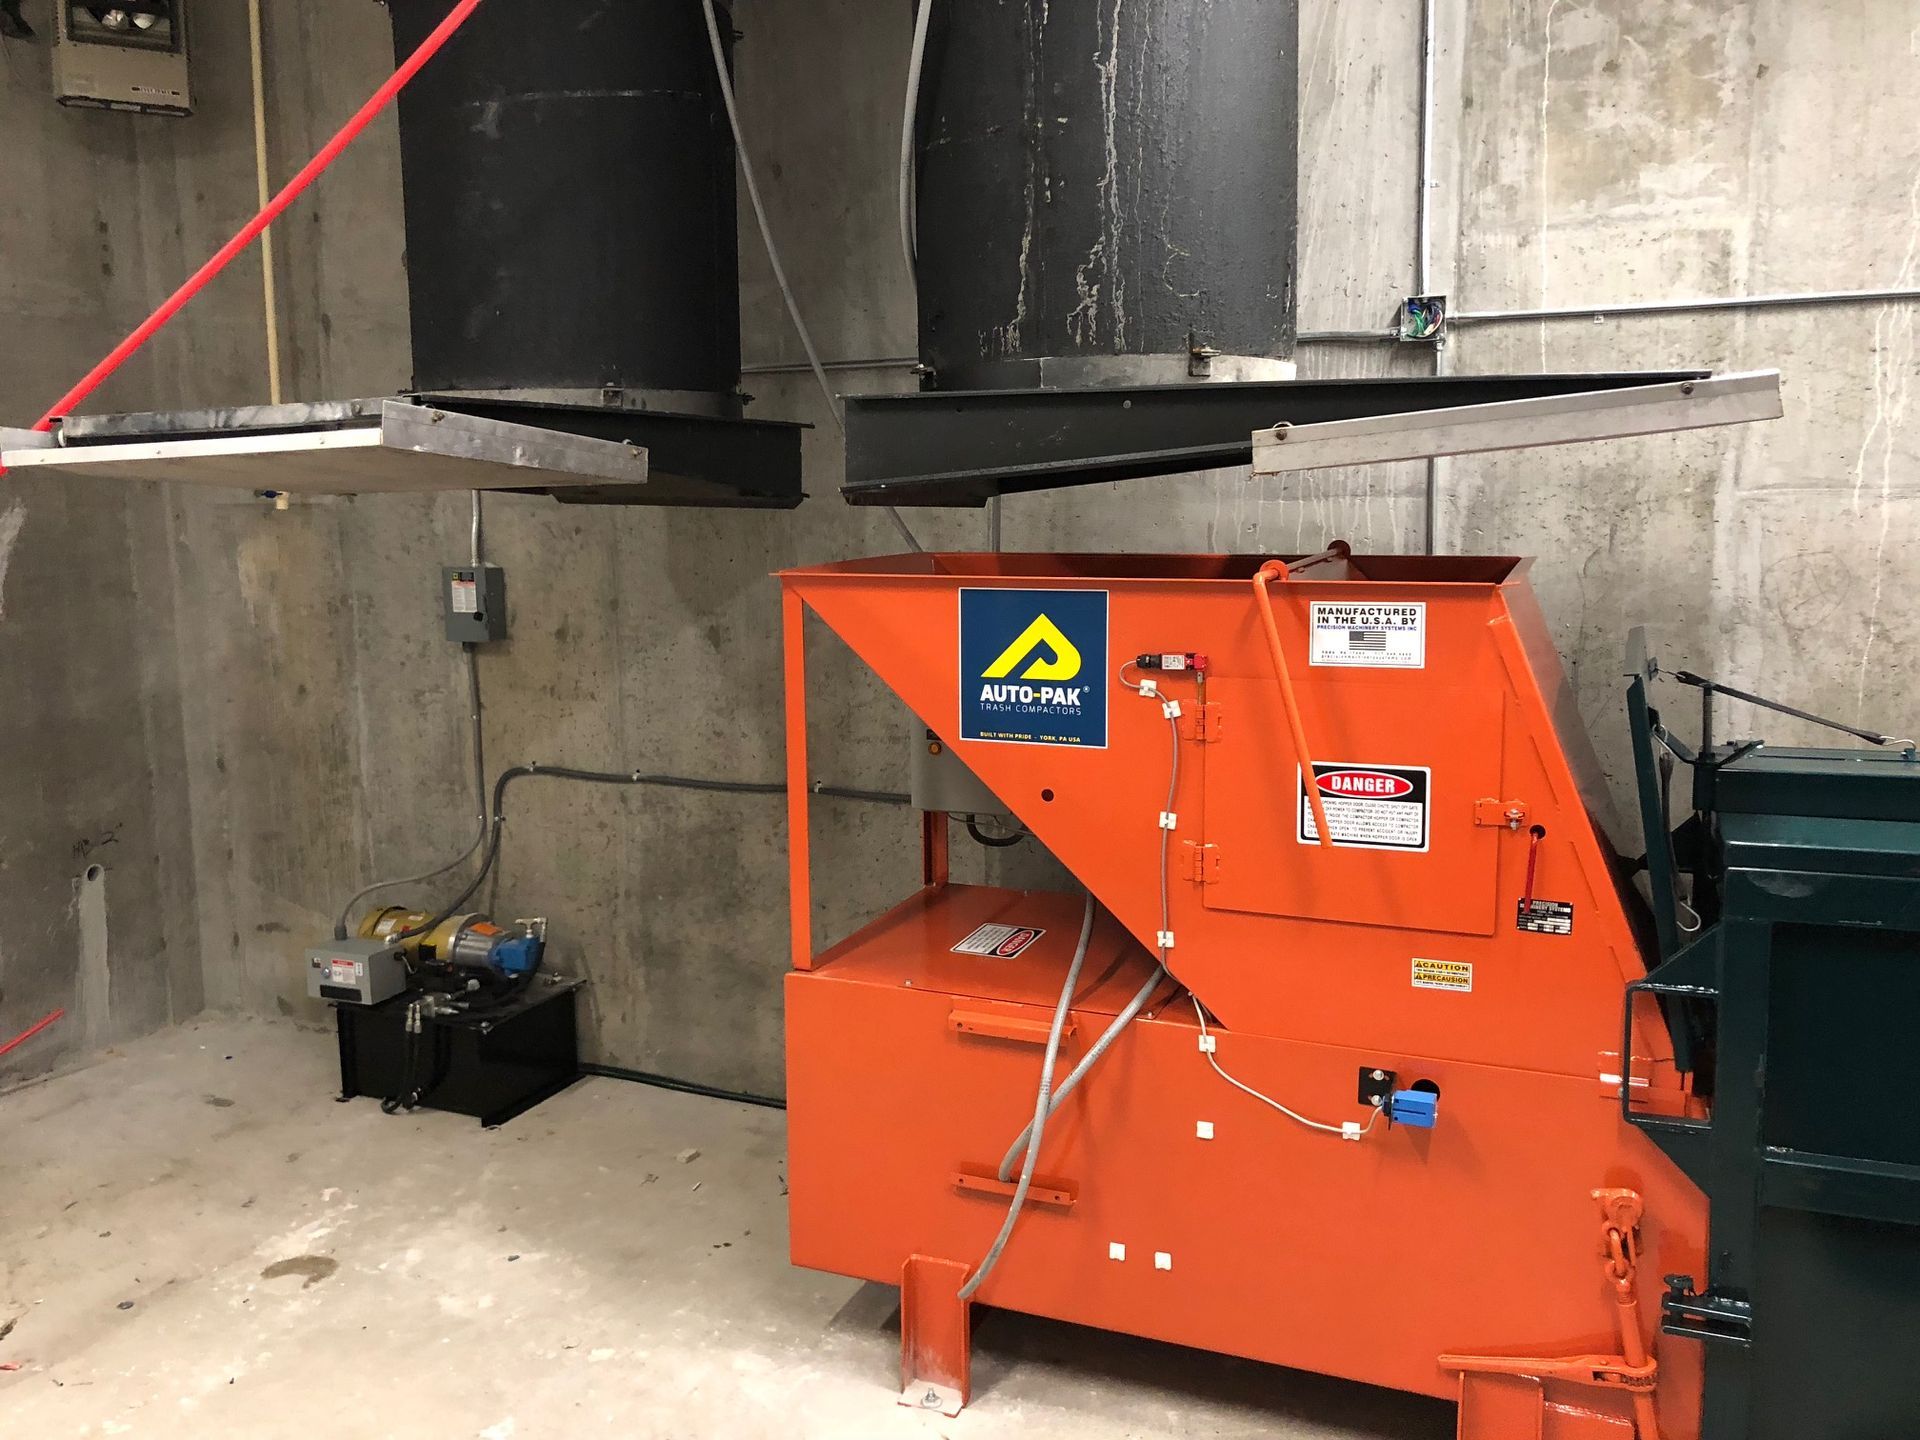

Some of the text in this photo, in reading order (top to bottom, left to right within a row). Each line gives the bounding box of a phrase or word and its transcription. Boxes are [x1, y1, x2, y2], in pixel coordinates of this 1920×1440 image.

[1317, 607, 1417, 616] MANUFACTURED
[1317, 616, 1416, 626] IN THE U.S.A. BY
[980, 702, 1082, 716] TRASH COMPACTORS
[1331, 775, 1396, 794] DANGER
[1422, 962, 1468, 971] CAUTION
[1422, 974, 1468, 984] PRECAUSION
